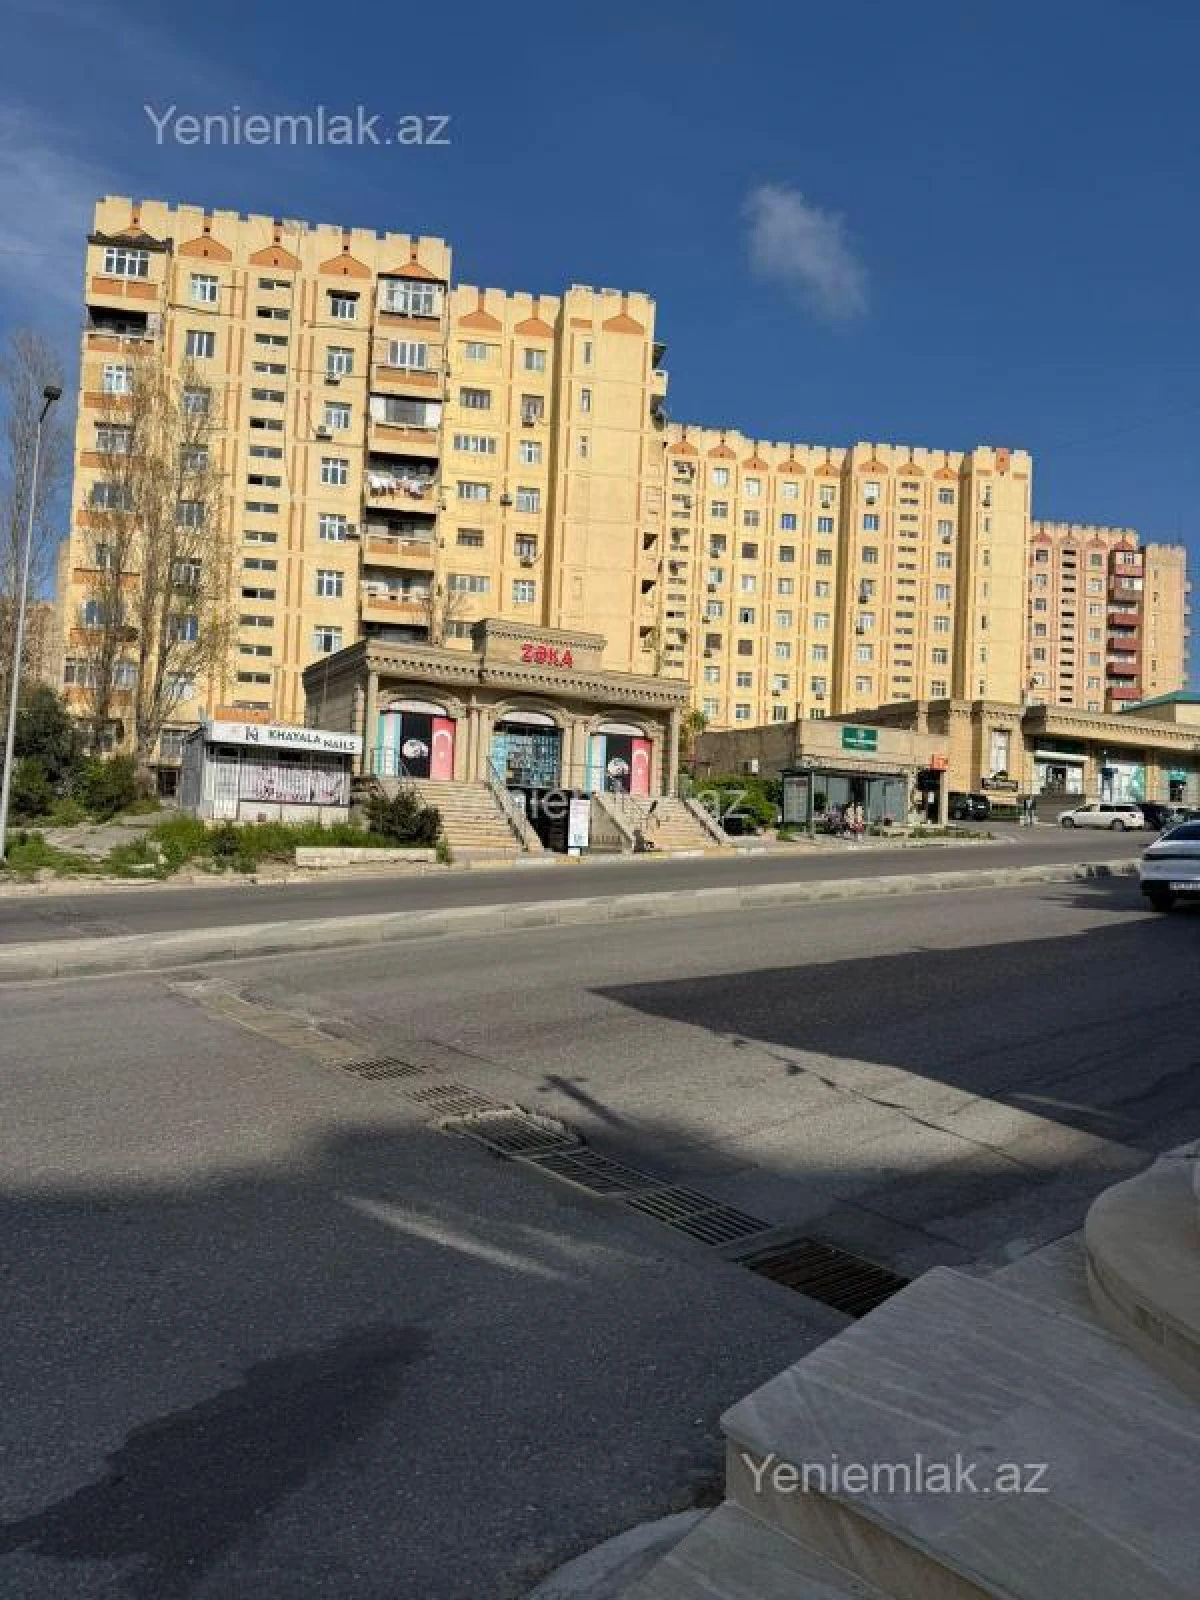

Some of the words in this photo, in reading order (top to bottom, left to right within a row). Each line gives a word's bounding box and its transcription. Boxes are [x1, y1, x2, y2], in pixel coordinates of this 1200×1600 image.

[521, 643, 573, 668] ZƏKA
[267, 729, 321, 744] KHAYALA
[323, 738, 355, 751] NAILS
